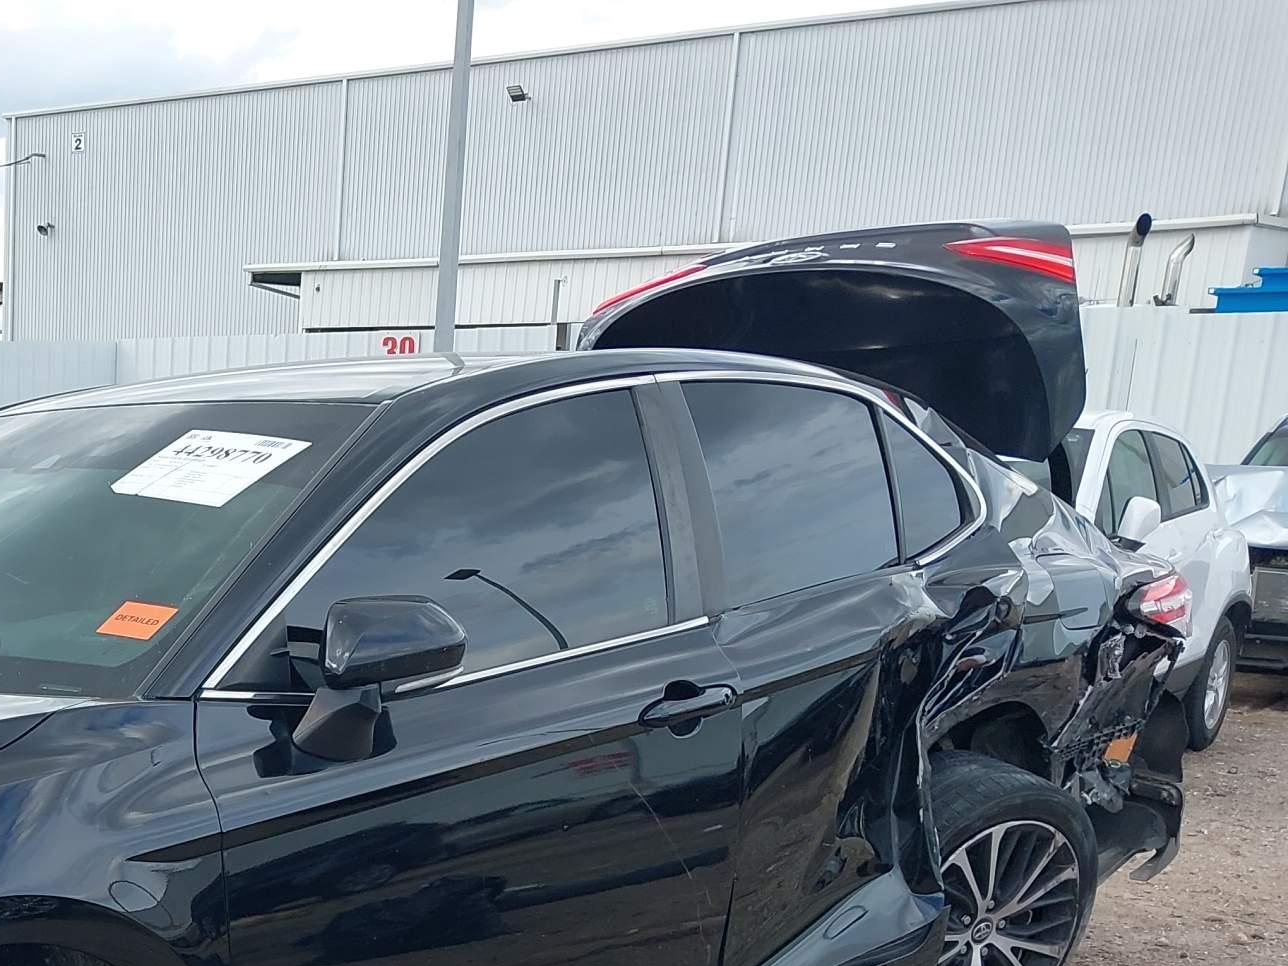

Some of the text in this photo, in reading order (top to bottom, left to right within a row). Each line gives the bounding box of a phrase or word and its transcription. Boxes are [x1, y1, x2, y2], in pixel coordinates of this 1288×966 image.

[74, 138, 82, 150] 2
[173, 444, 273, 464] 44298770
[114, 613, 160, 626] DETAILED
